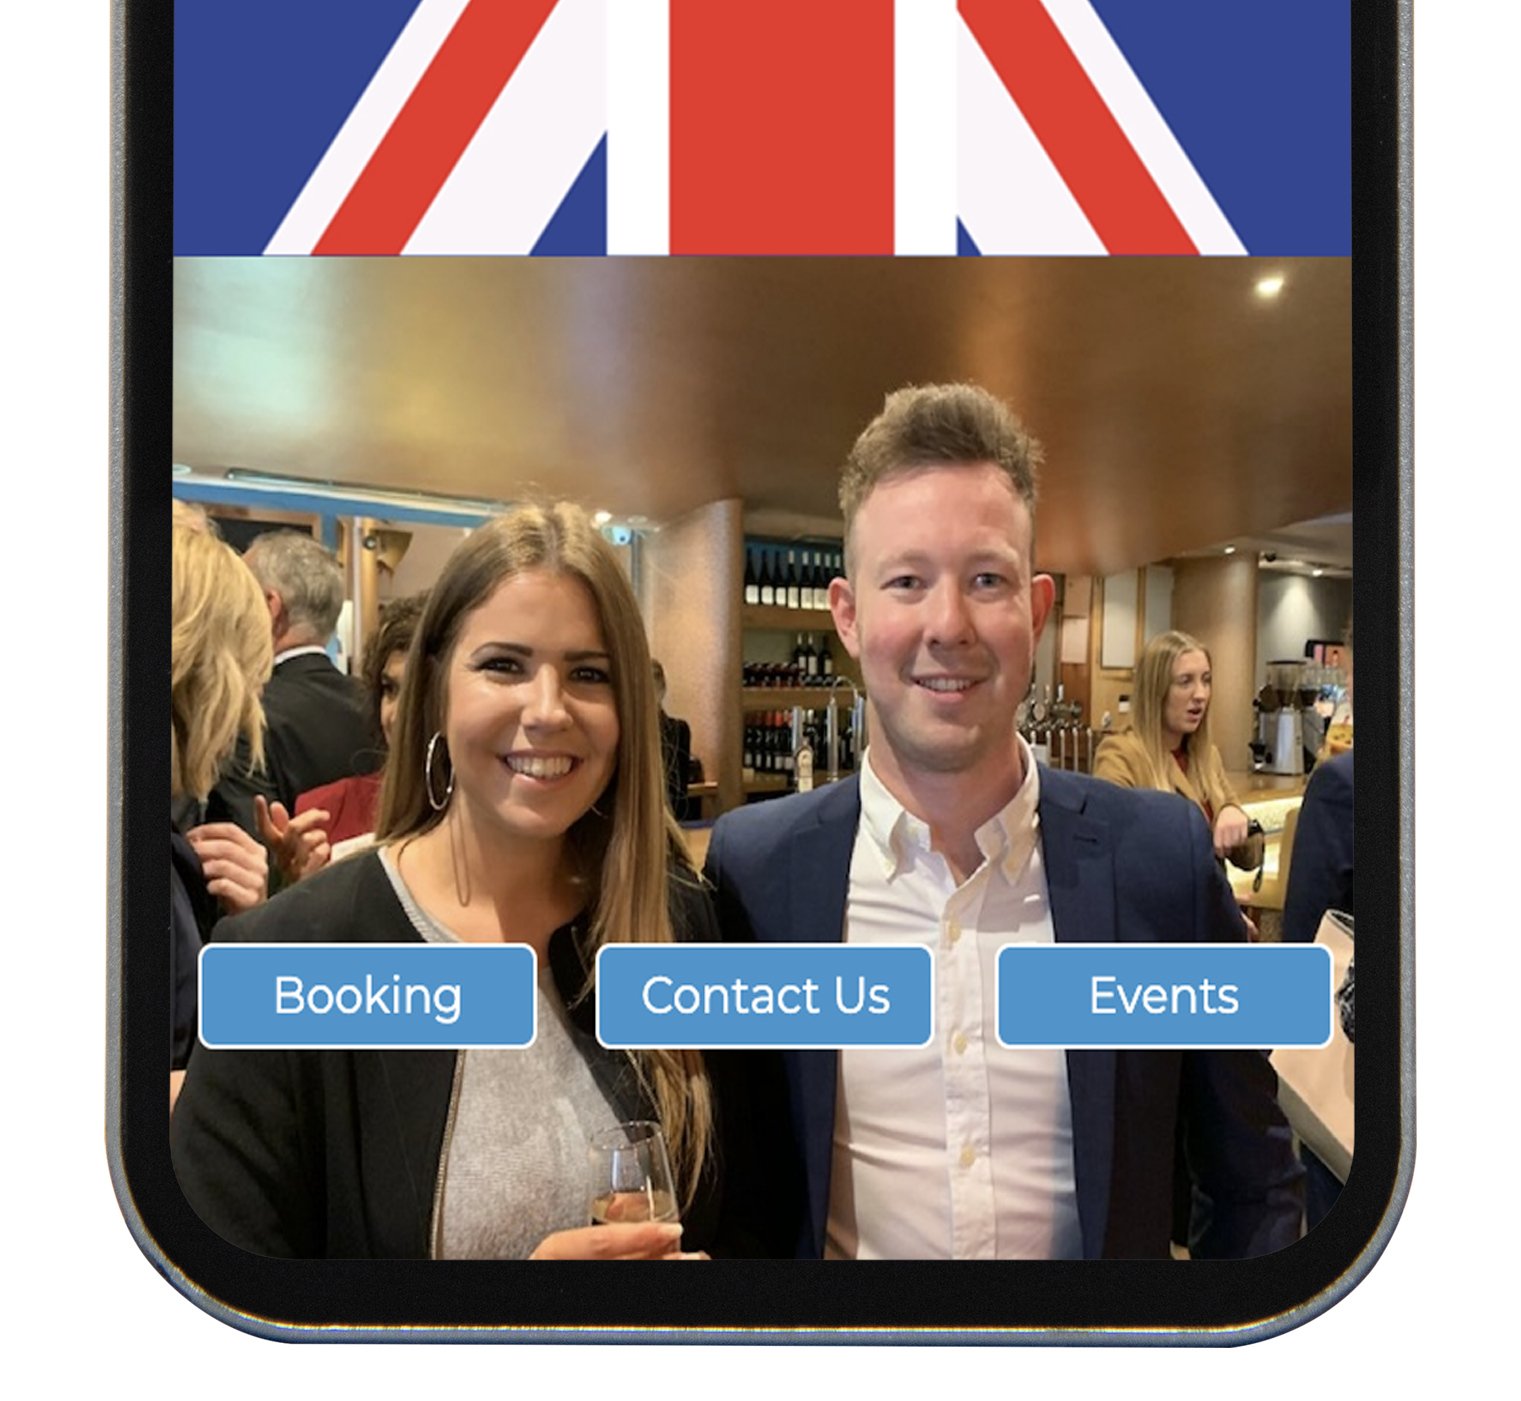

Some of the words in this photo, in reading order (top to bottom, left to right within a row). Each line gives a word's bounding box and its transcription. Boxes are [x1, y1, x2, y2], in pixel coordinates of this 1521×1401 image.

[275, 973, 461, 1025] Booking
[641, 975, 821, 1015] Contact
[835, 975, 891, 1015] Us
[1091, 975, 1239, 1015] Events
